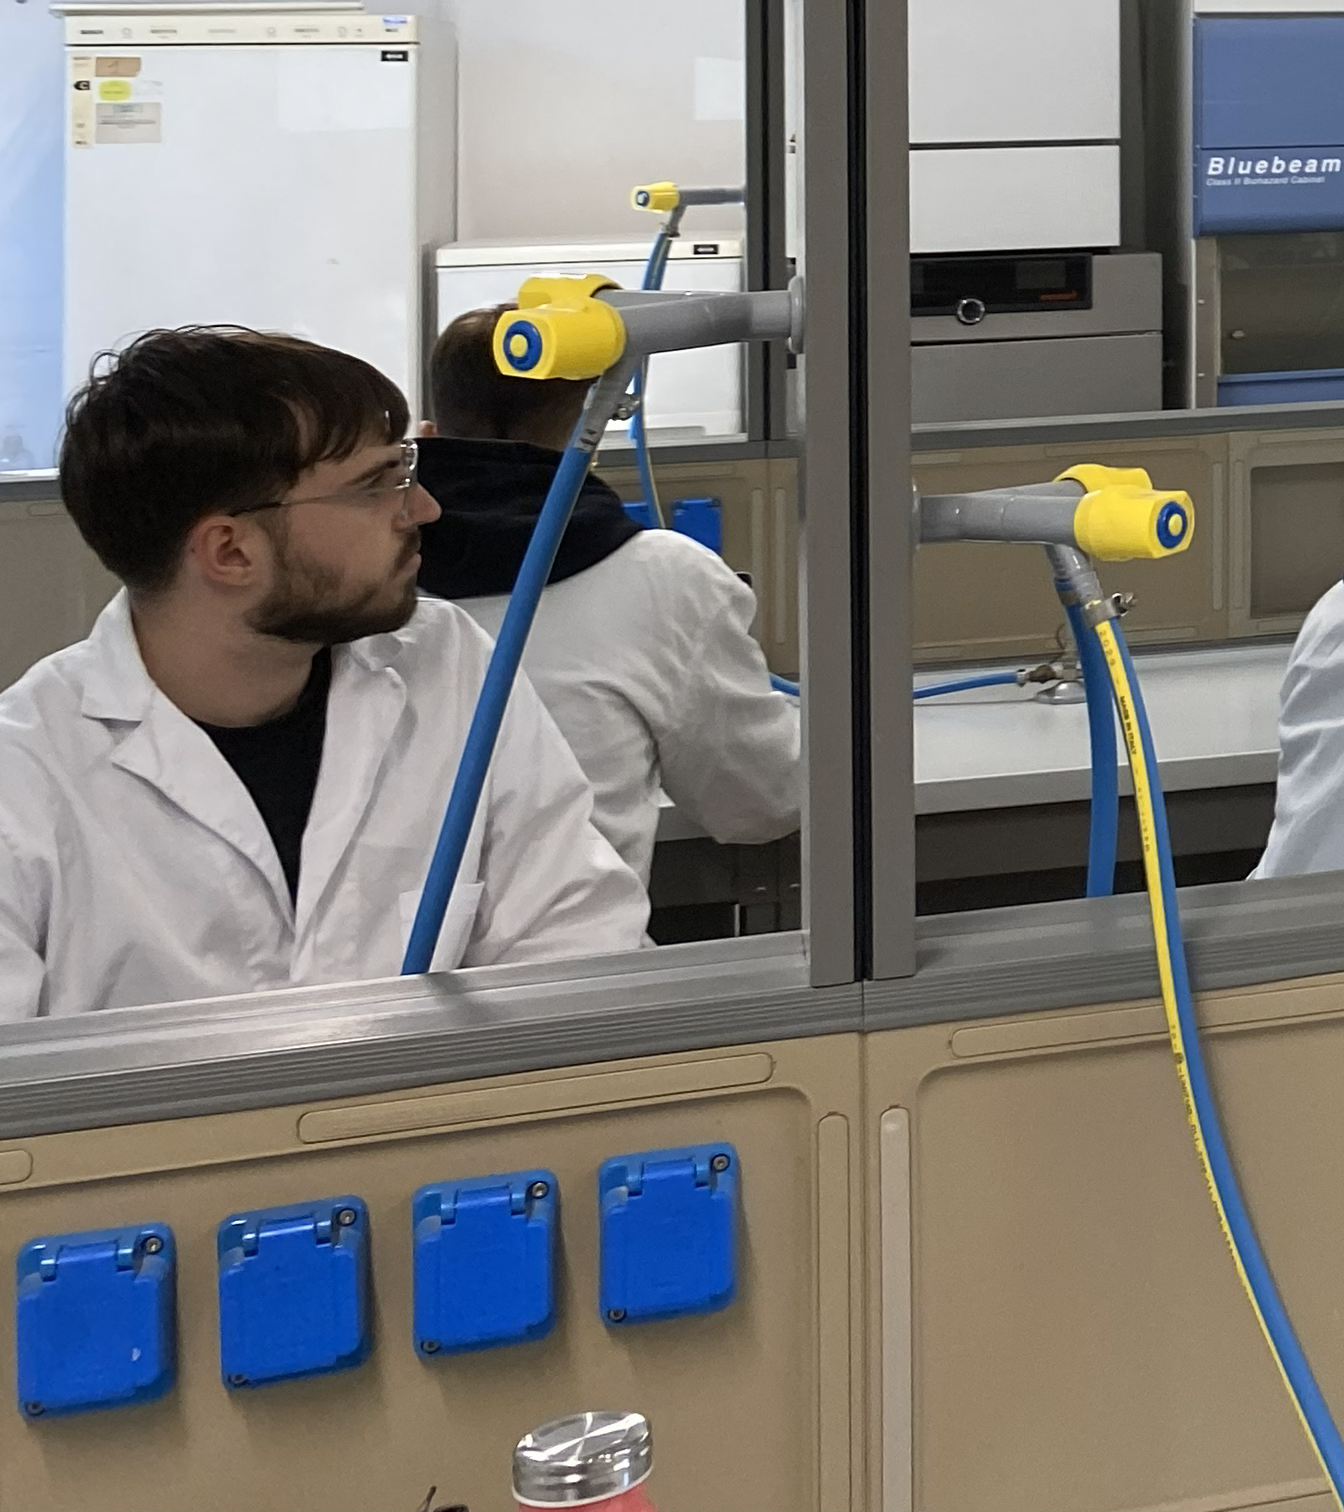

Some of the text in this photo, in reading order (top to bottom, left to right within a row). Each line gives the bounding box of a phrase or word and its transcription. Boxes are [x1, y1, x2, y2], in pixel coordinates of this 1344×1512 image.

[1207, 156, 1342, 176] Bluebeam
[1206, 178, 1232, 186] Class
[1119, 695, 1129, 720] MADE
[1127, 733, 1138, 756] ITALY
